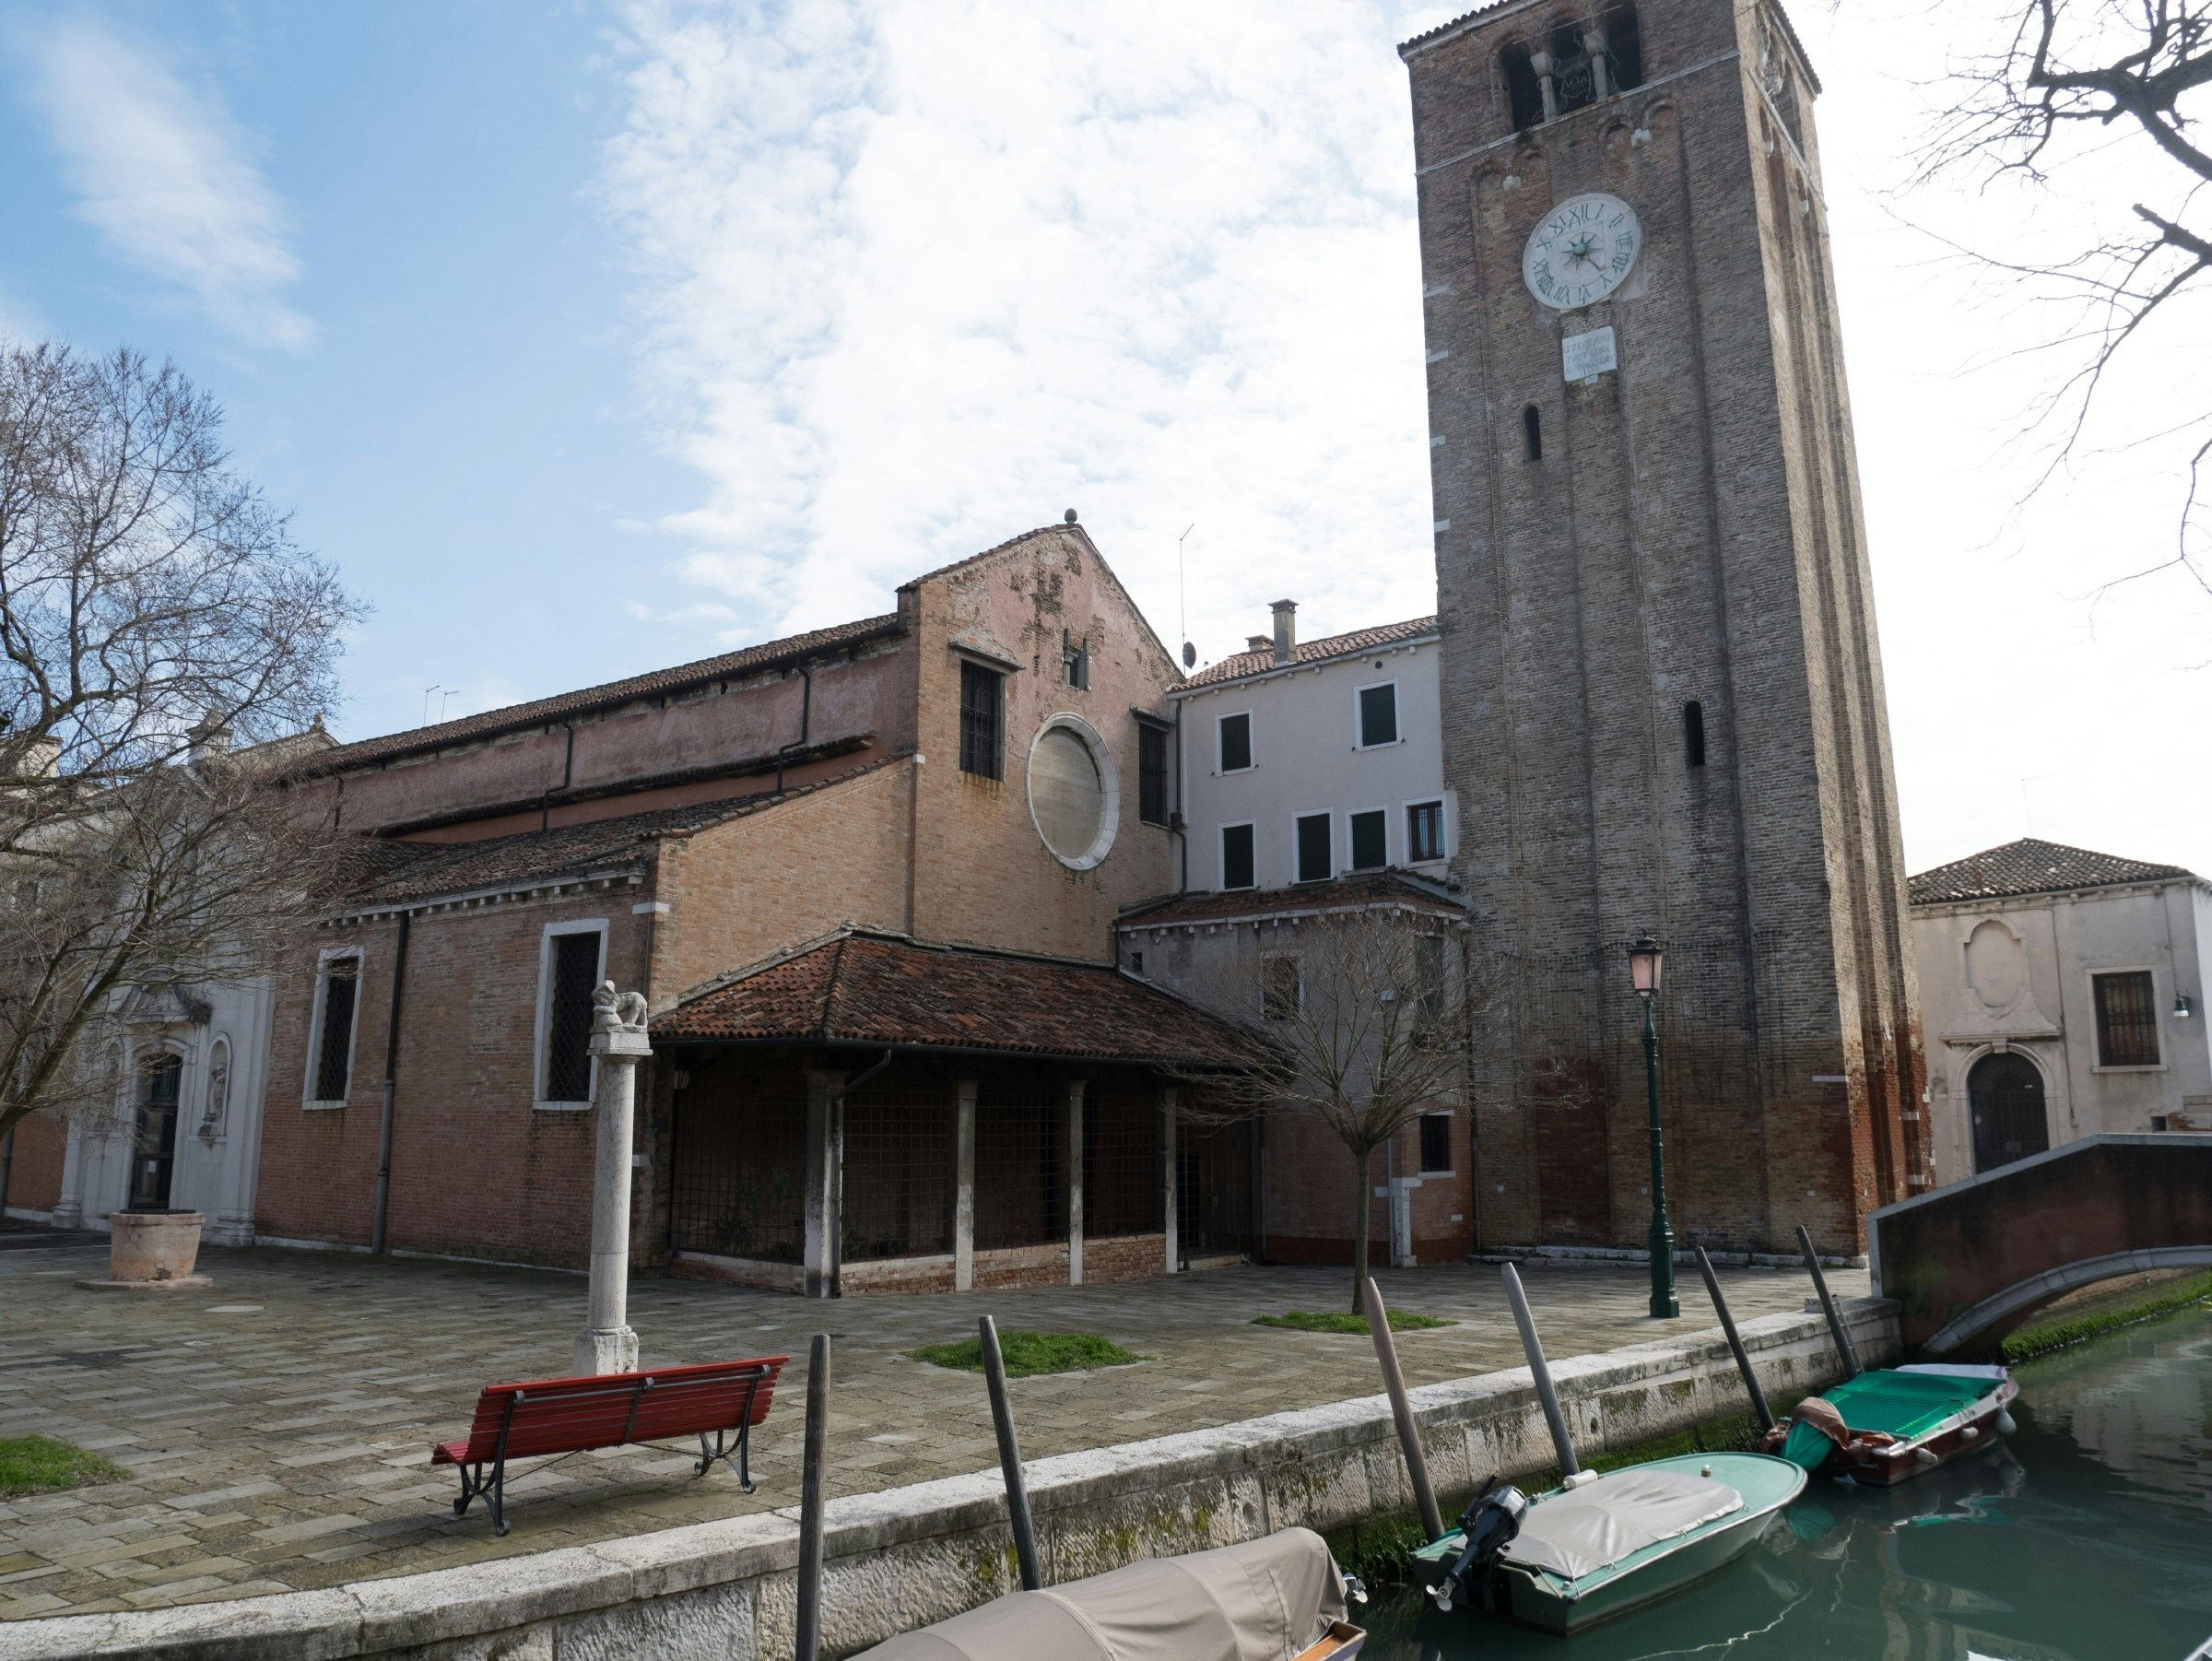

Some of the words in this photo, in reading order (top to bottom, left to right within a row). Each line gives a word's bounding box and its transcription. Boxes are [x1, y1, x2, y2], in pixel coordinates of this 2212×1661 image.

[1548, 216, 1567, 237] XI
[1568, 204, 1589, 228] XII
[1536, 238, 1552, 251] X
[1600, 274, 1614, 289] V
[1578, 284, 1592, 305] VI
